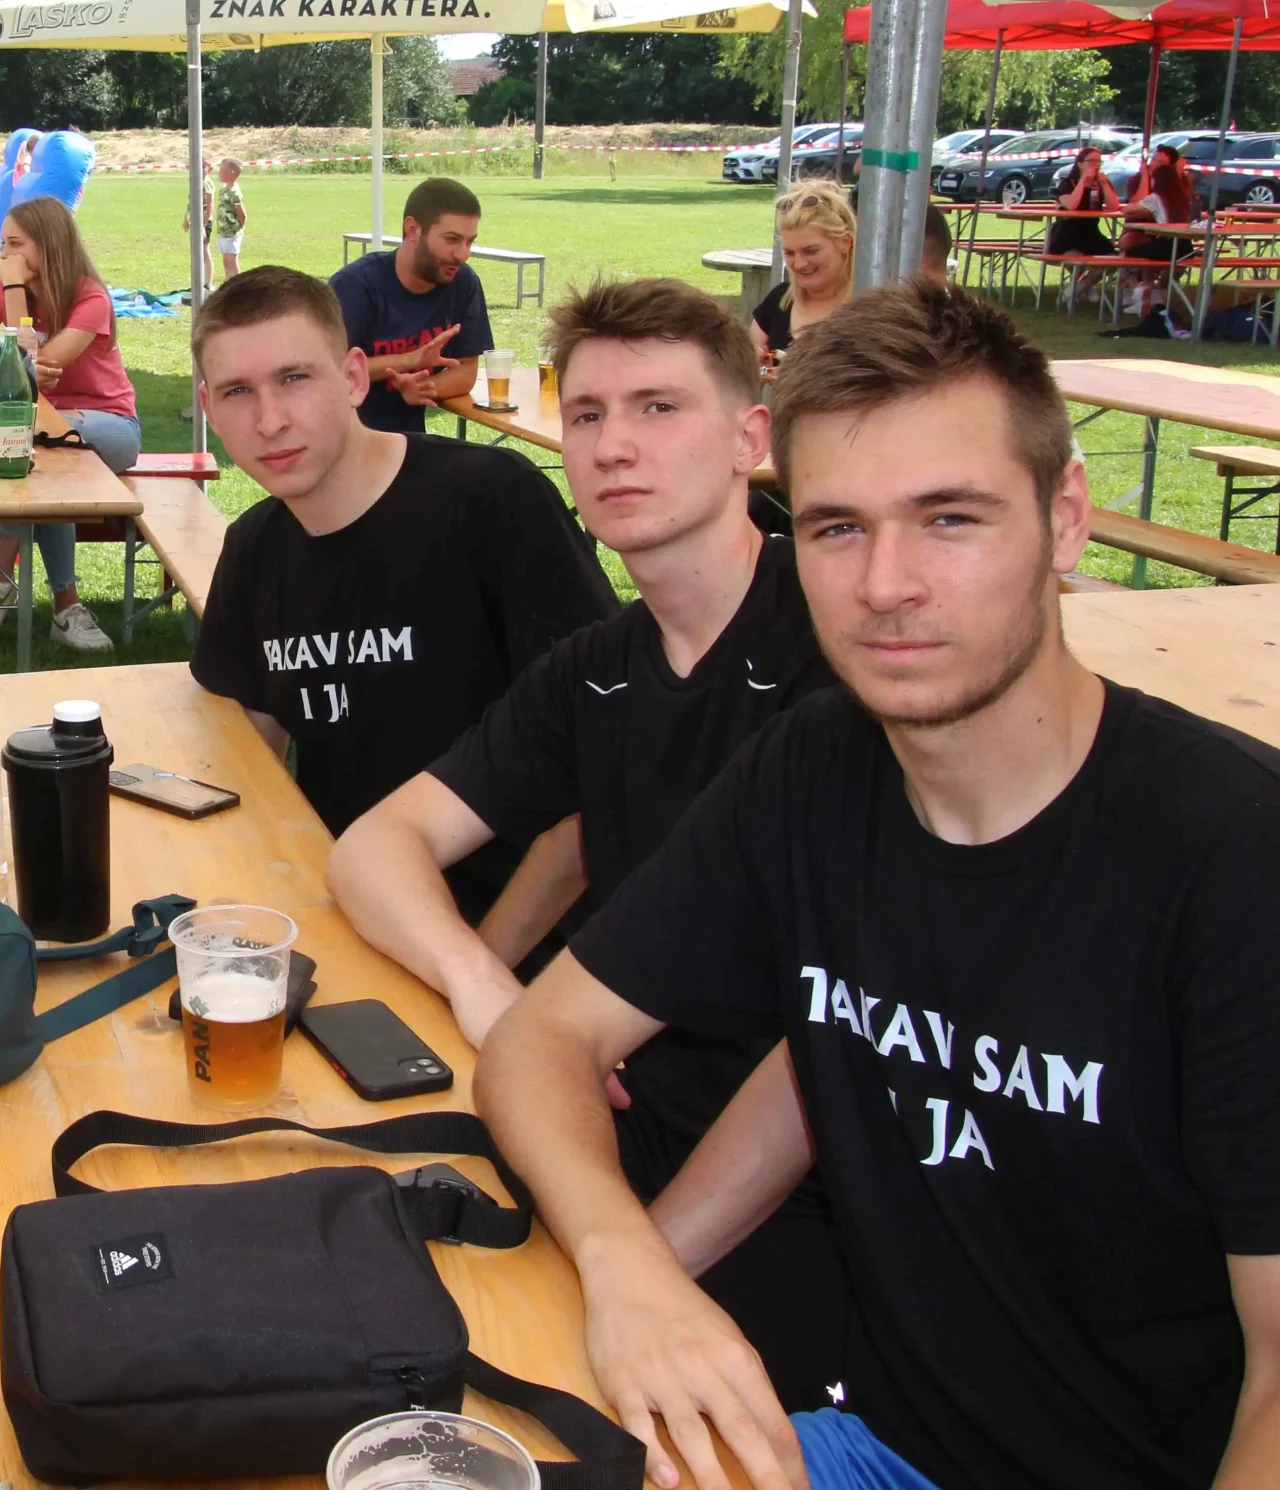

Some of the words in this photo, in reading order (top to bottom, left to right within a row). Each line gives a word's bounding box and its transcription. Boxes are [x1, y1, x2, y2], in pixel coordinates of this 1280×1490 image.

[209, 0, 287, 18] ZNAK
[298, 0, 491, 18] KARAKTERA.
[373, 323, 453, 355] DREA
[263, 632, 339, 671] TAKAV
[348, 626, 414, 664] SAM
[300, 688, 314, 720] I
[323, 683, 349, 723] JA
[192, 1021, 212, 1083] PAN
[973, 1035, 1104, 1125] SAM
[920, 1097, 995, 1171] JA
